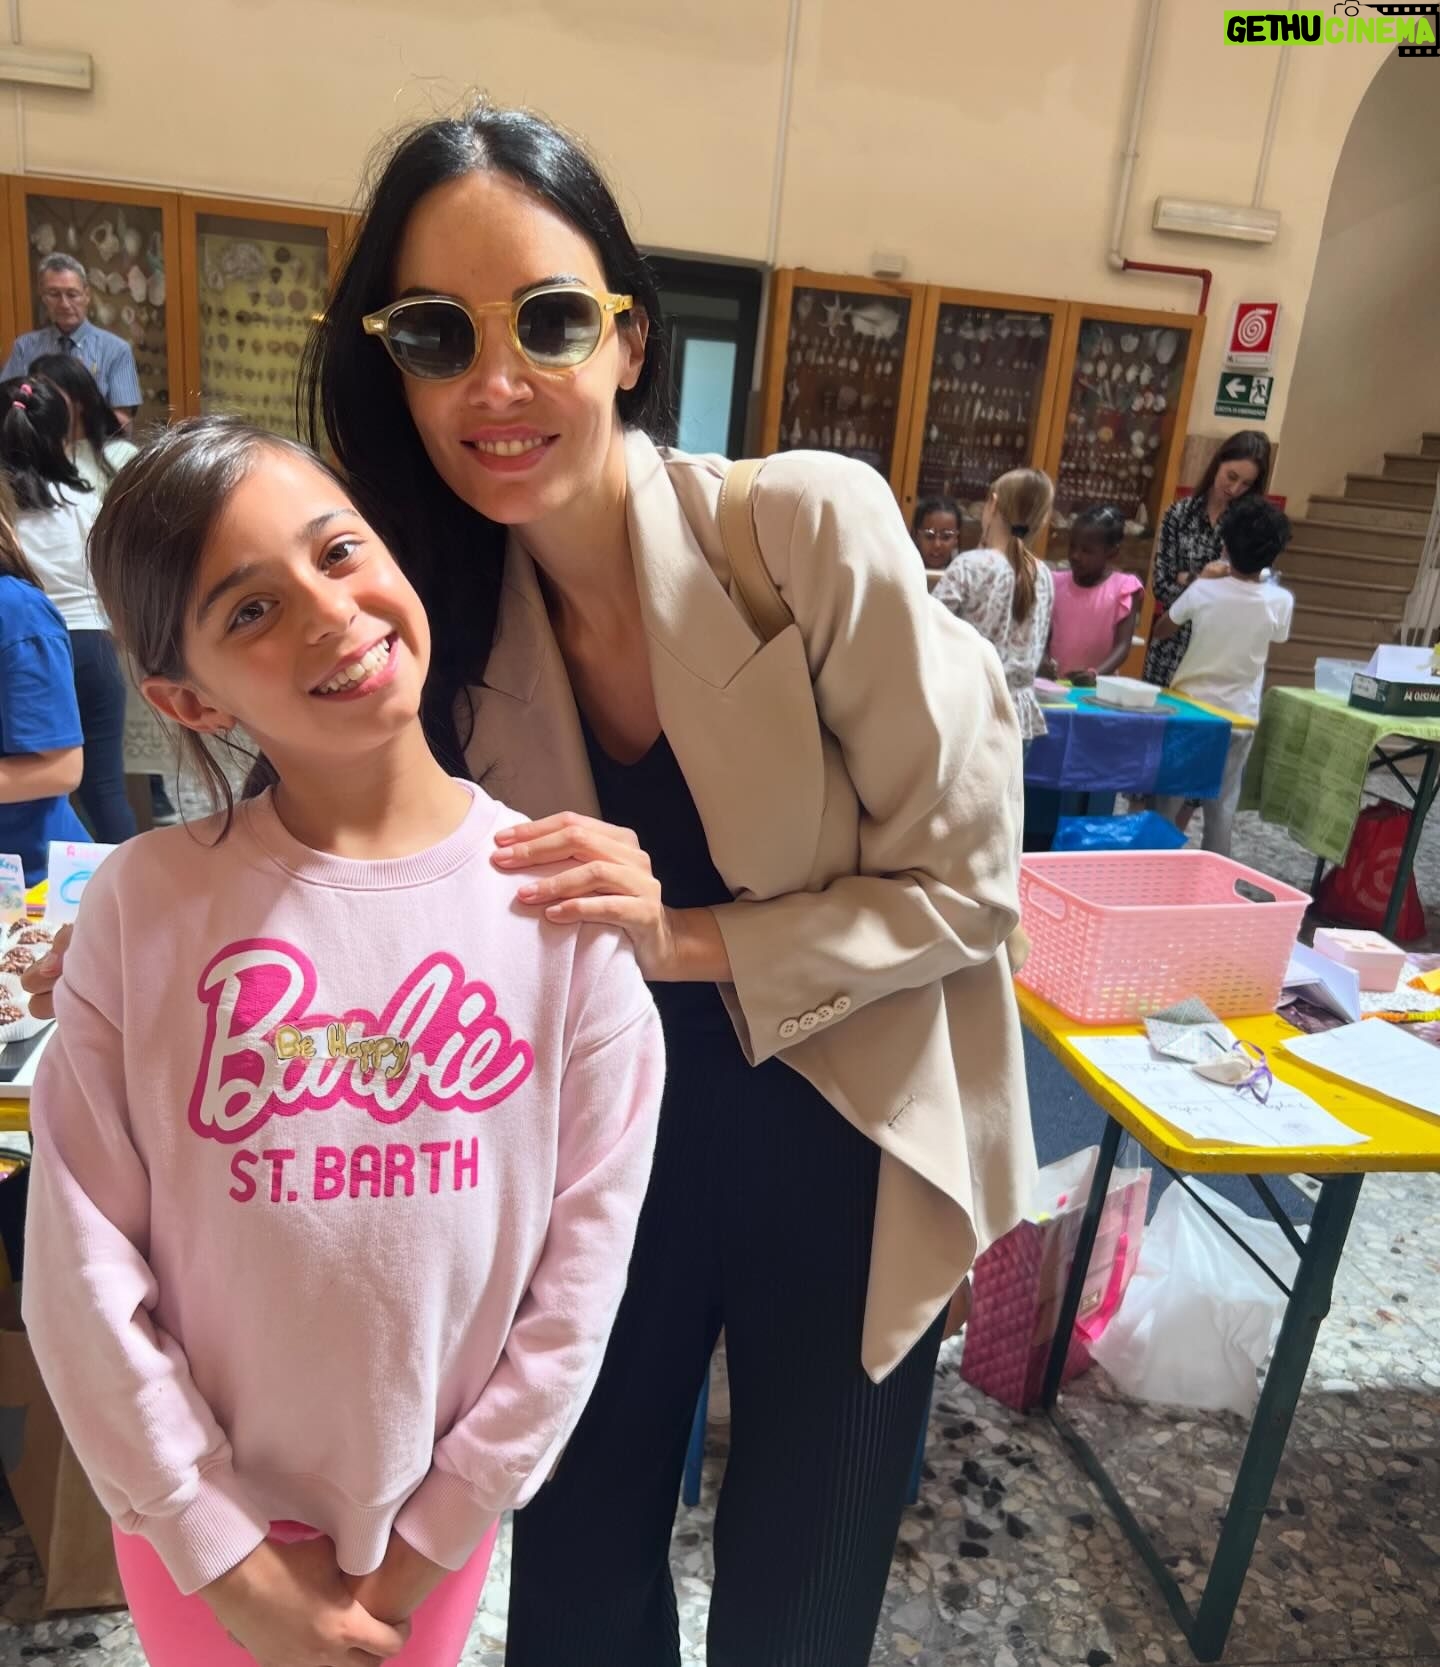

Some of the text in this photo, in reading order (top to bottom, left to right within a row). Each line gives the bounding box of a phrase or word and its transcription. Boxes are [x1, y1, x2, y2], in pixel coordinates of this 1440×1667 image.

[194, 943, 531, 1137] Barbie
[276, 1023, 409, 1079] Be Happy
[229, 1136, 479, 1203] ST. BARTH
